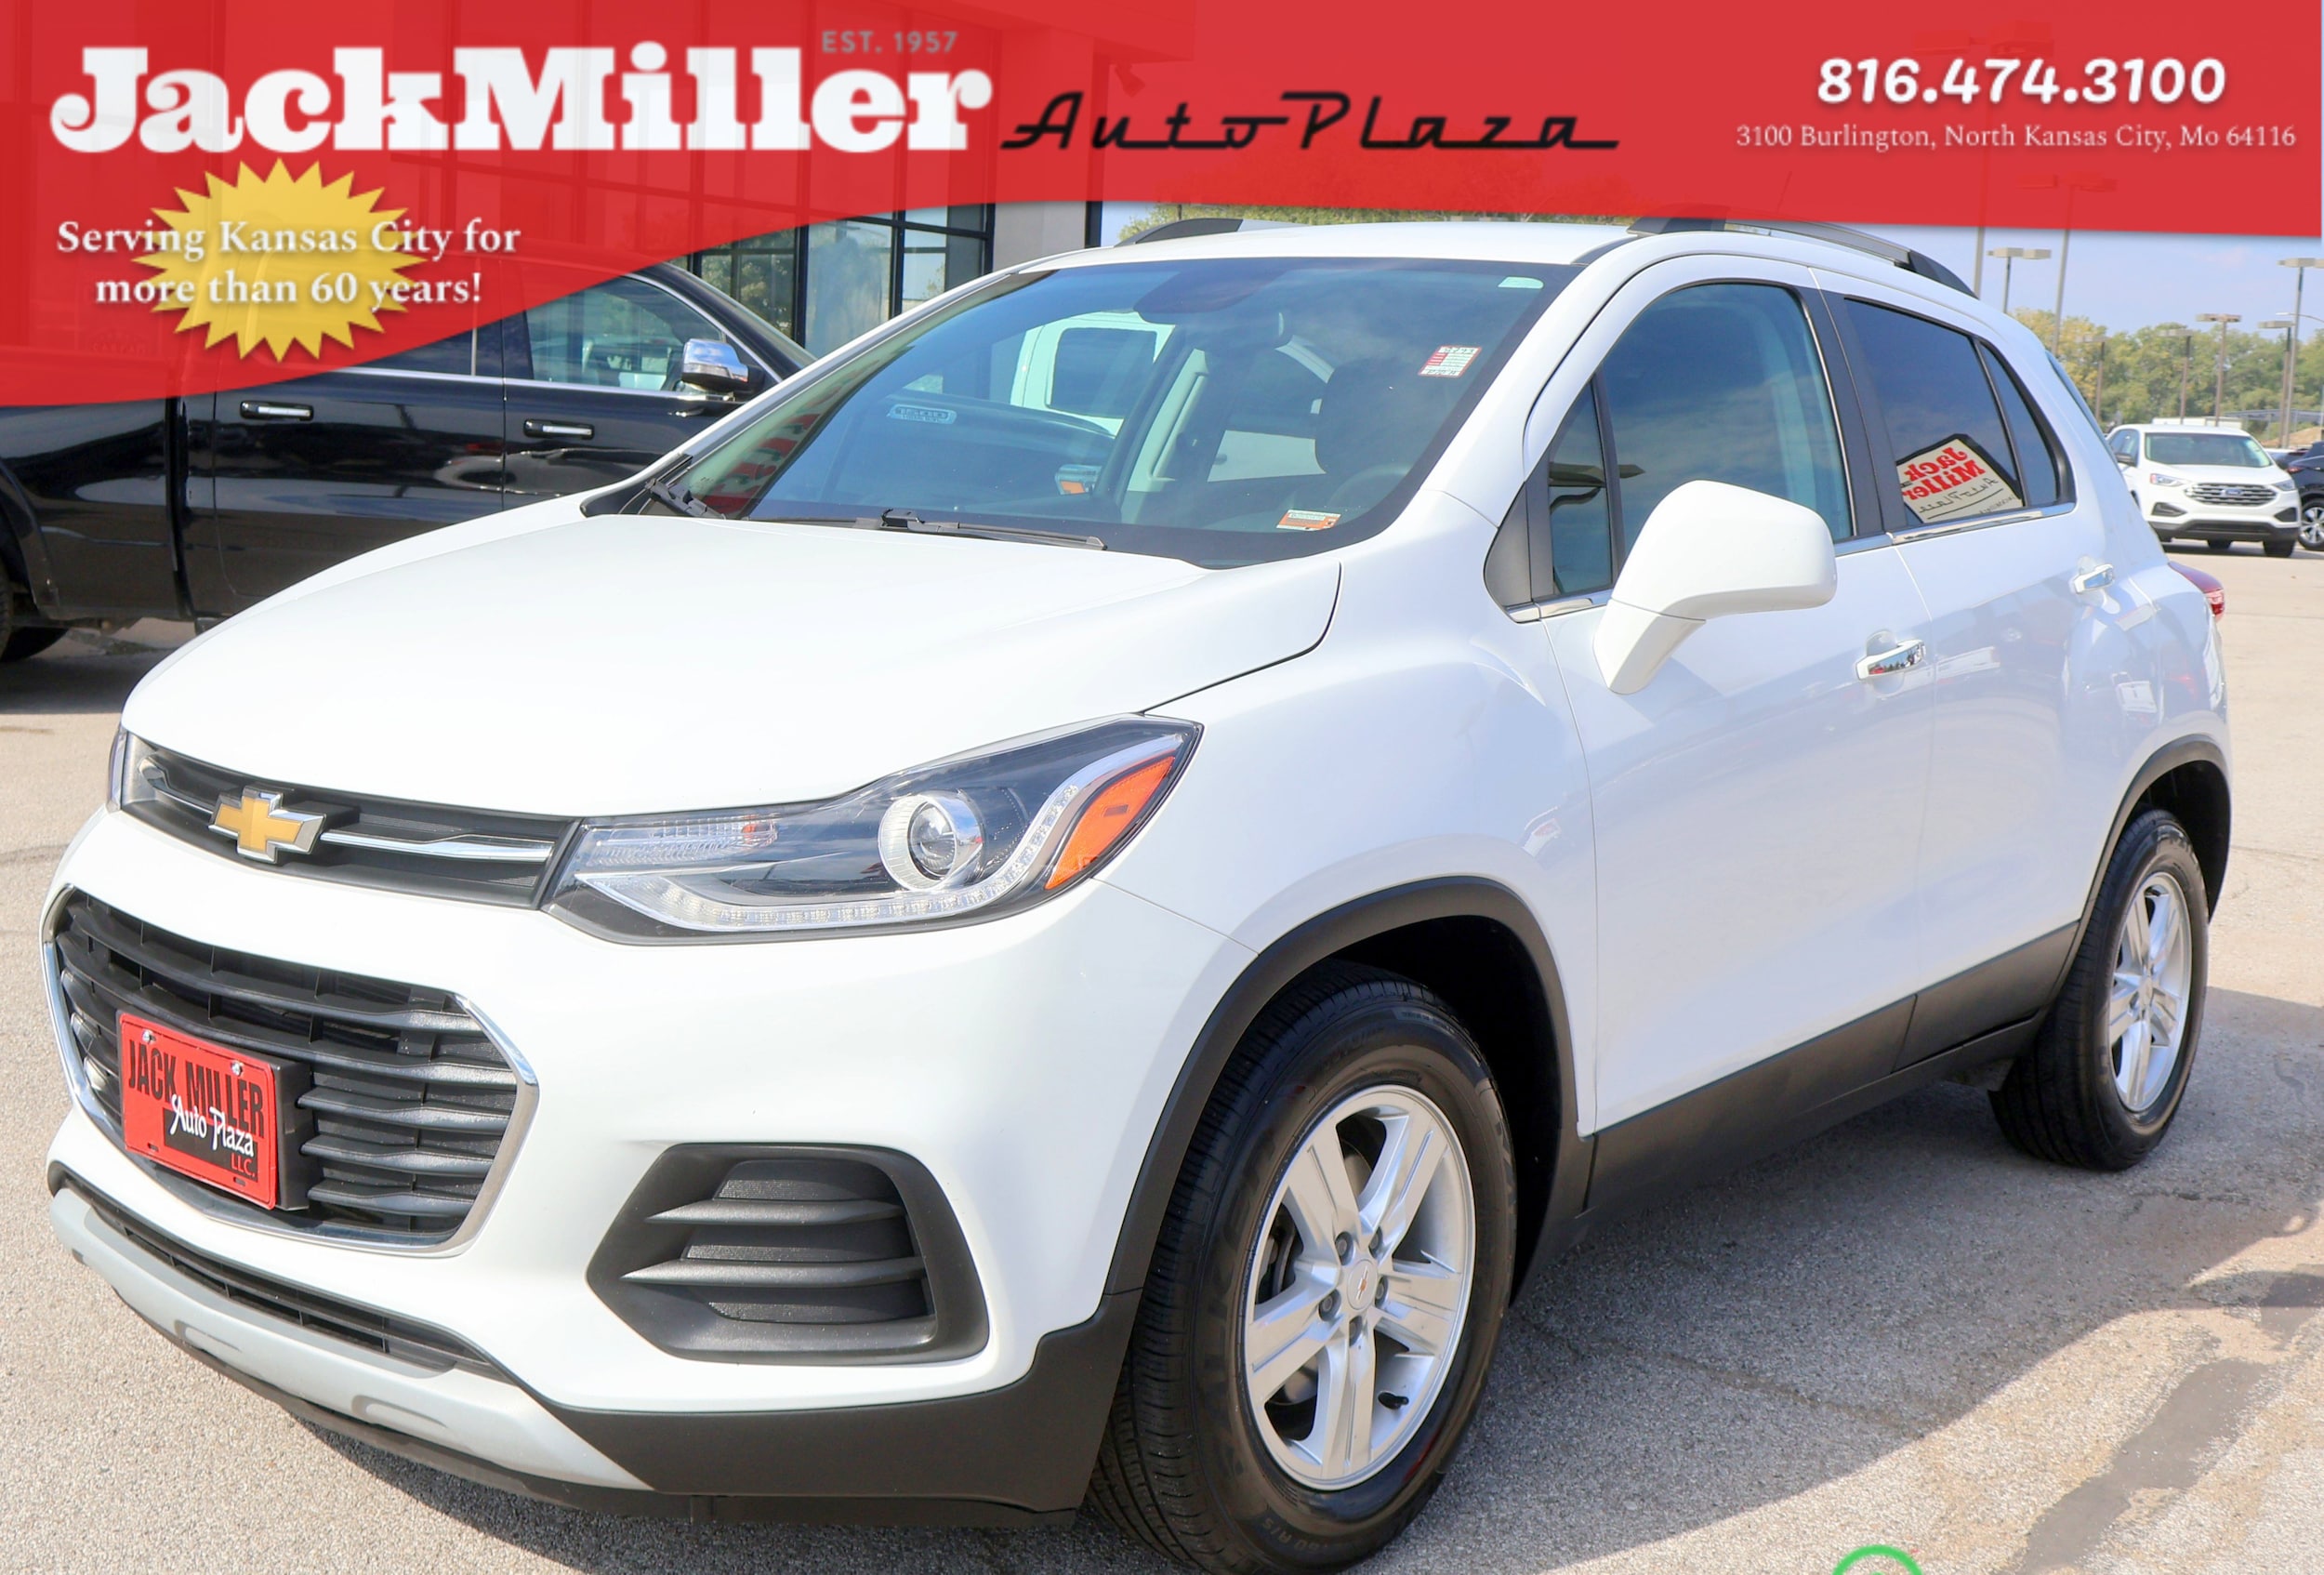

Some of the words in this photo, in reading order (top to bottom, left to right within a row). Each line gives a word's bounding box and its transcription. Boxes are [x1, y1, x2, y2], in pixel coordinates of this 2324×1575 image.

[128, 1039, 177, 1104] JACK
[186, 1061, 265, 1139] MILLER
[169, 1093, 207, 1139] Auto
[209, 1105, 255, 1158] Plaza
[231, 1151, 256, 1178] LLC.
